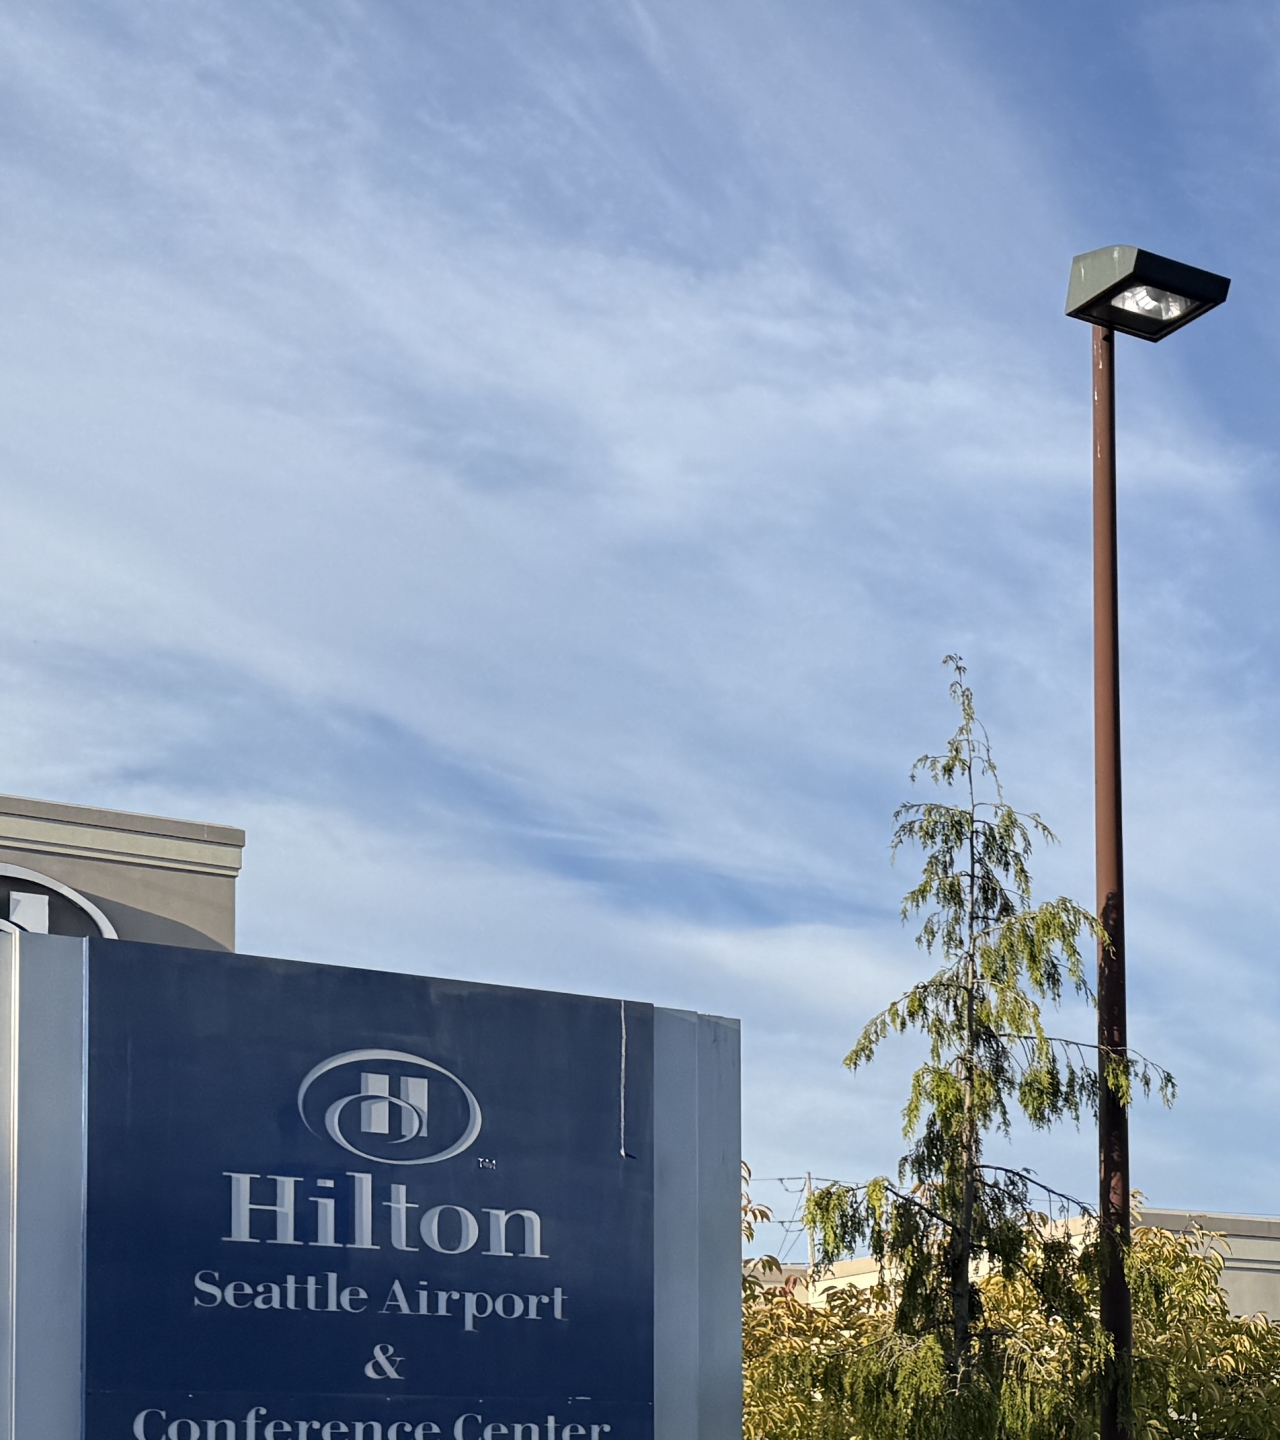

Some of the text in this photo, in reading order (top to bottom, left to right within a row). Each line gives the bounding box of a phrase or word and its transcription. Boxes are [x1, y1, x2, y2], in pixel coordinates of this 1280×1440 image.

[221, 1171, 550, 1260] Hilton
[193, 1270, 569, 1331] Seattle Airport
[364, 1343, 405, 1380] &
